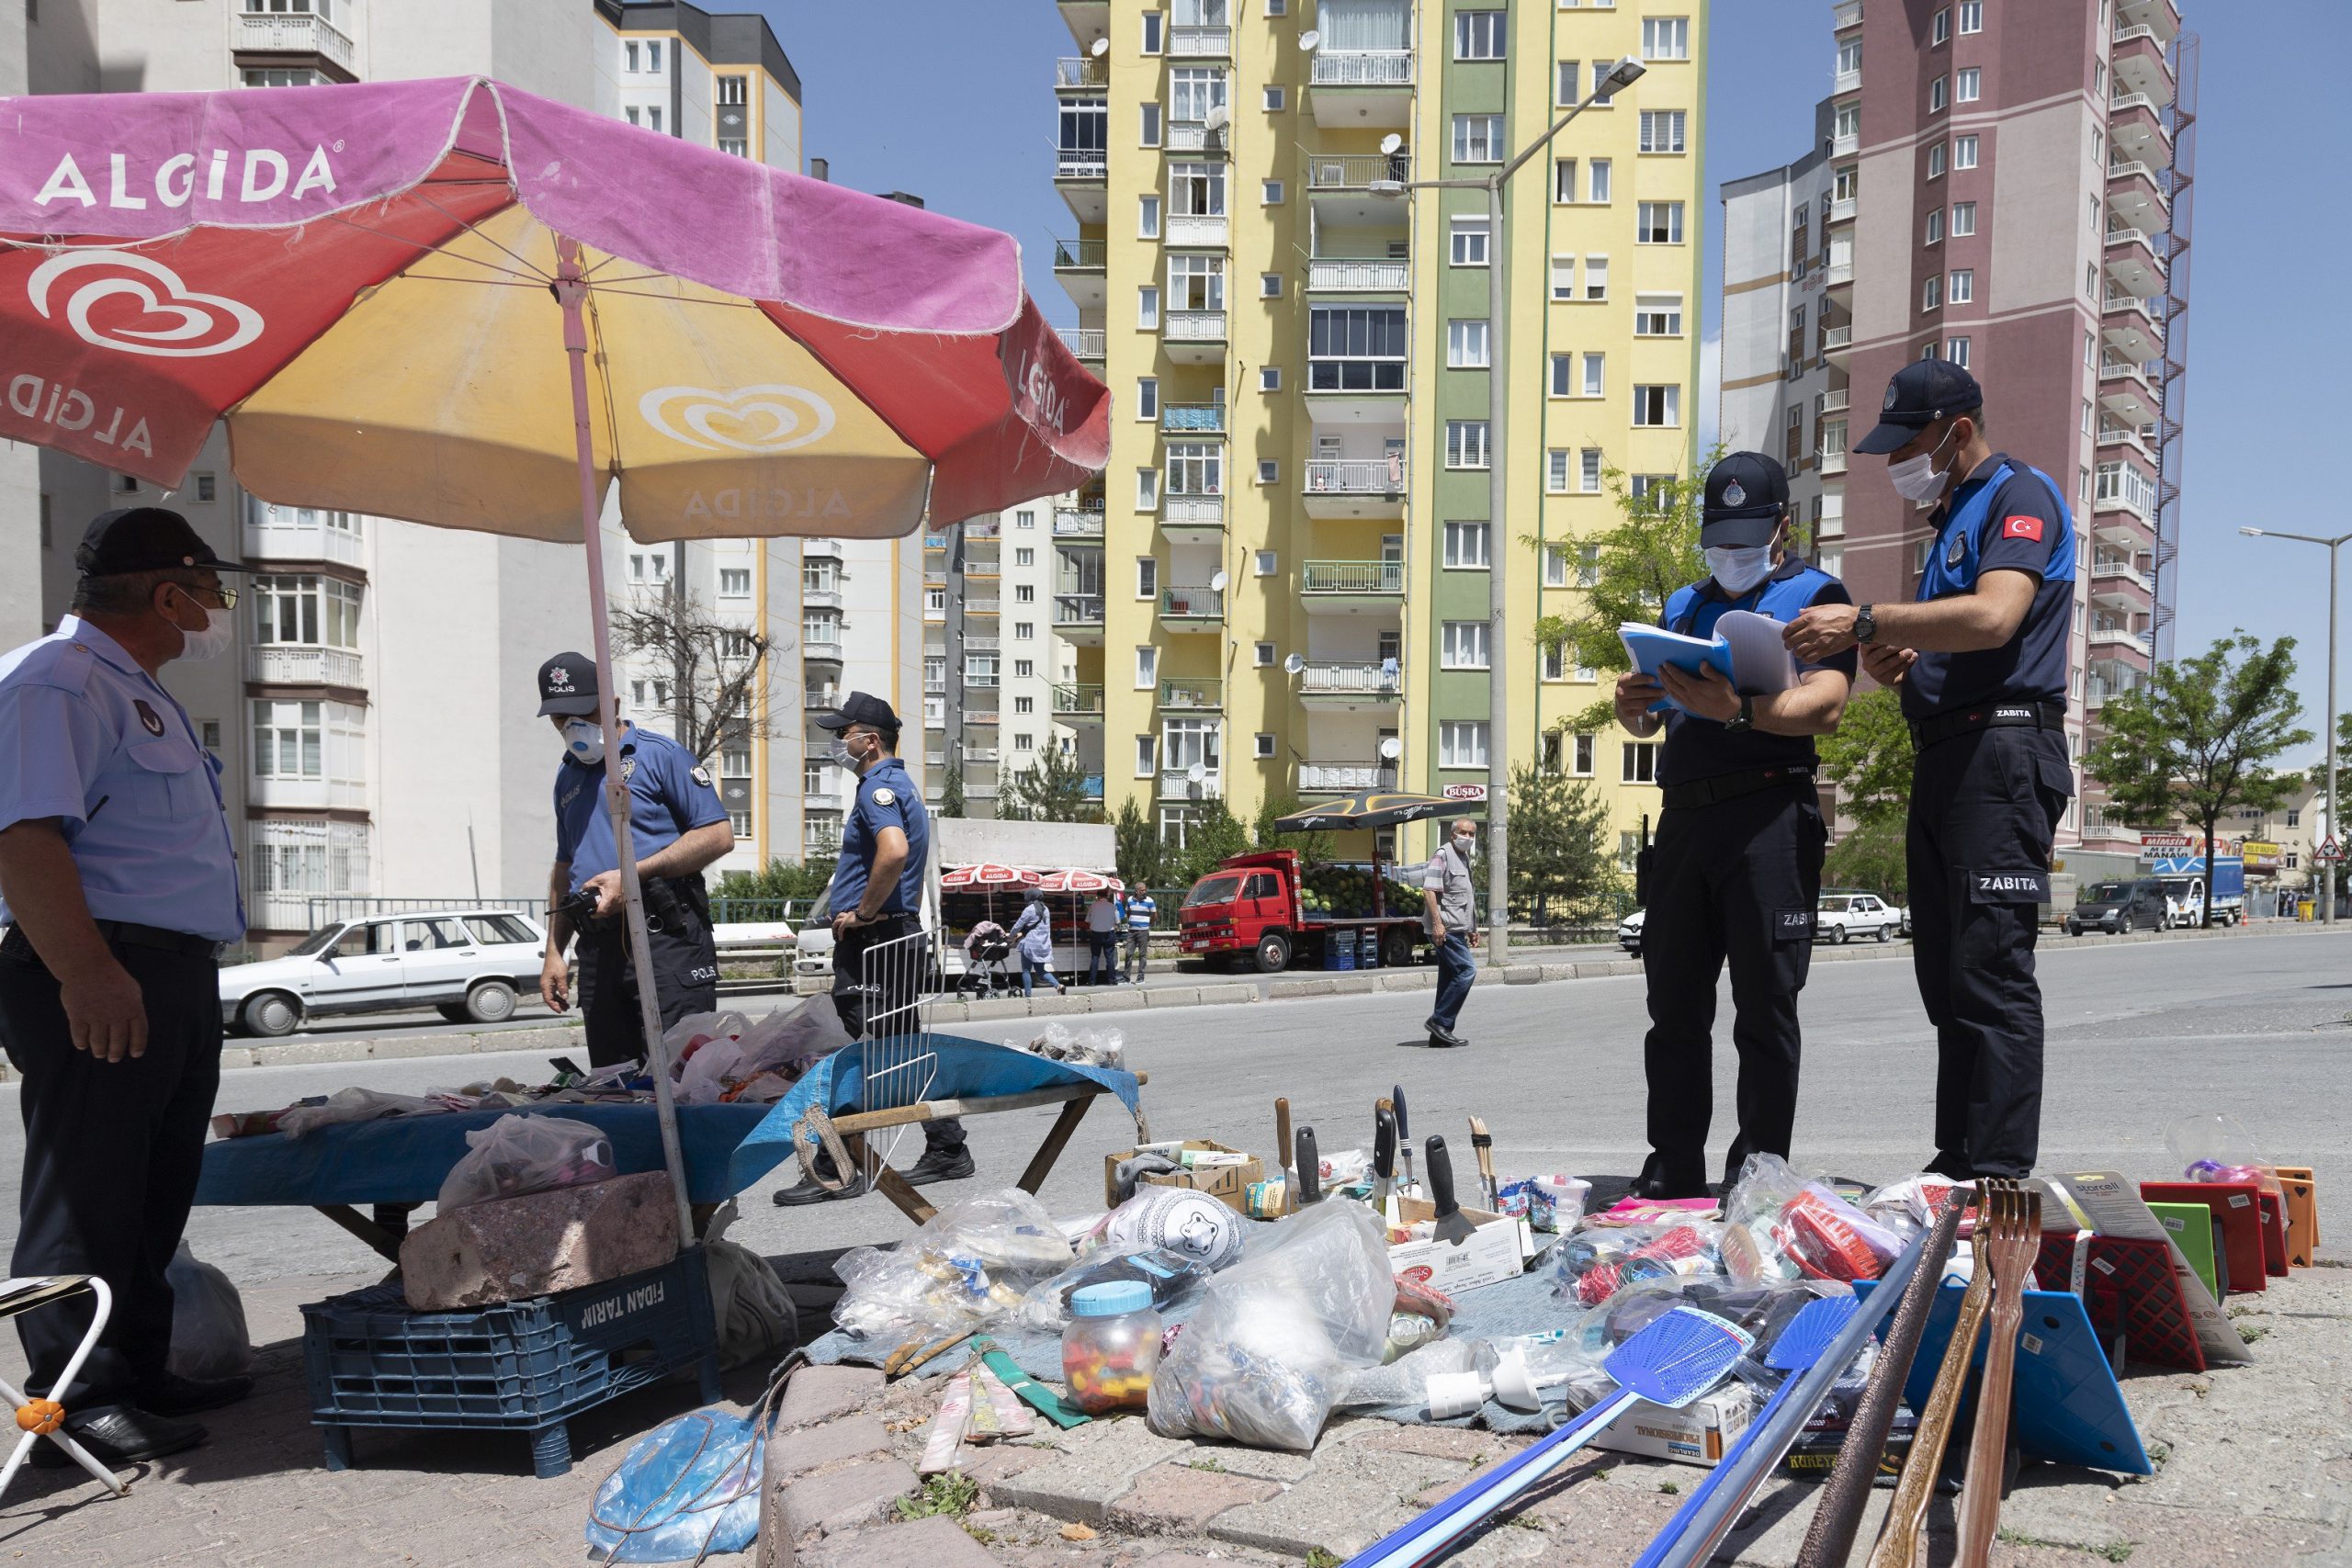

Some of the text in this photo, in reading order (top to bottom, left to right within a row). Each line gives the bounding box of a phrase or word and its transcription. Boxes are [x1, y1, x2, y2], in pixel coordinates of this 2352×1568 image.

[1996, 709, 2031, 717] ZABITA
[1449, 785, 1481, 798] BÜŞRA
[1979, 877, 2039, 891] ZABITA
[2076, 1182, 2120, 1192] starcell
[1635, 1425, 1701, 1444] PROFESSIONAL
[1668, 1446, 1700, 1458] DEARLING
